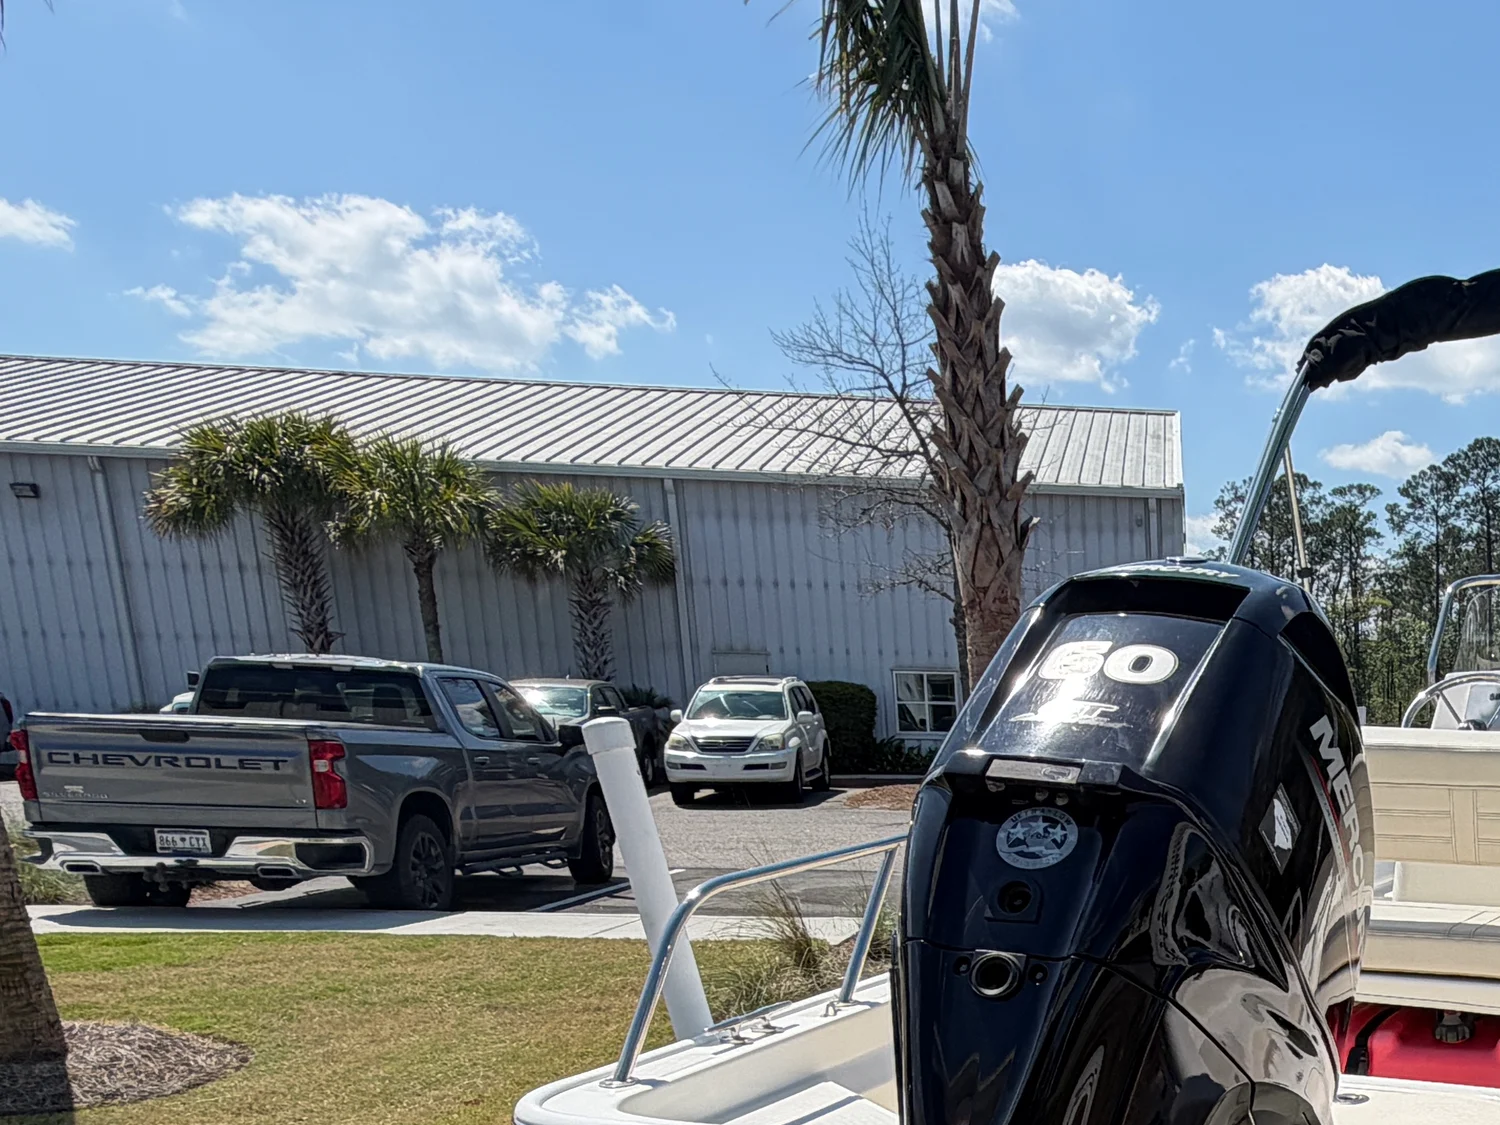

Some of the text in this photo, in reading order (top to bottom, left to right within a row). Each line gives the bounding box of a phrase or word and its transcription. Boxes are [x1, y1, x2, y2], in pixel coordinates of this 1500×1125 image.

[1038, 640, 1179, 685] 60
[47, 751, 288, 772] CHEVROLET
[158, 835, 178, 848] 866
